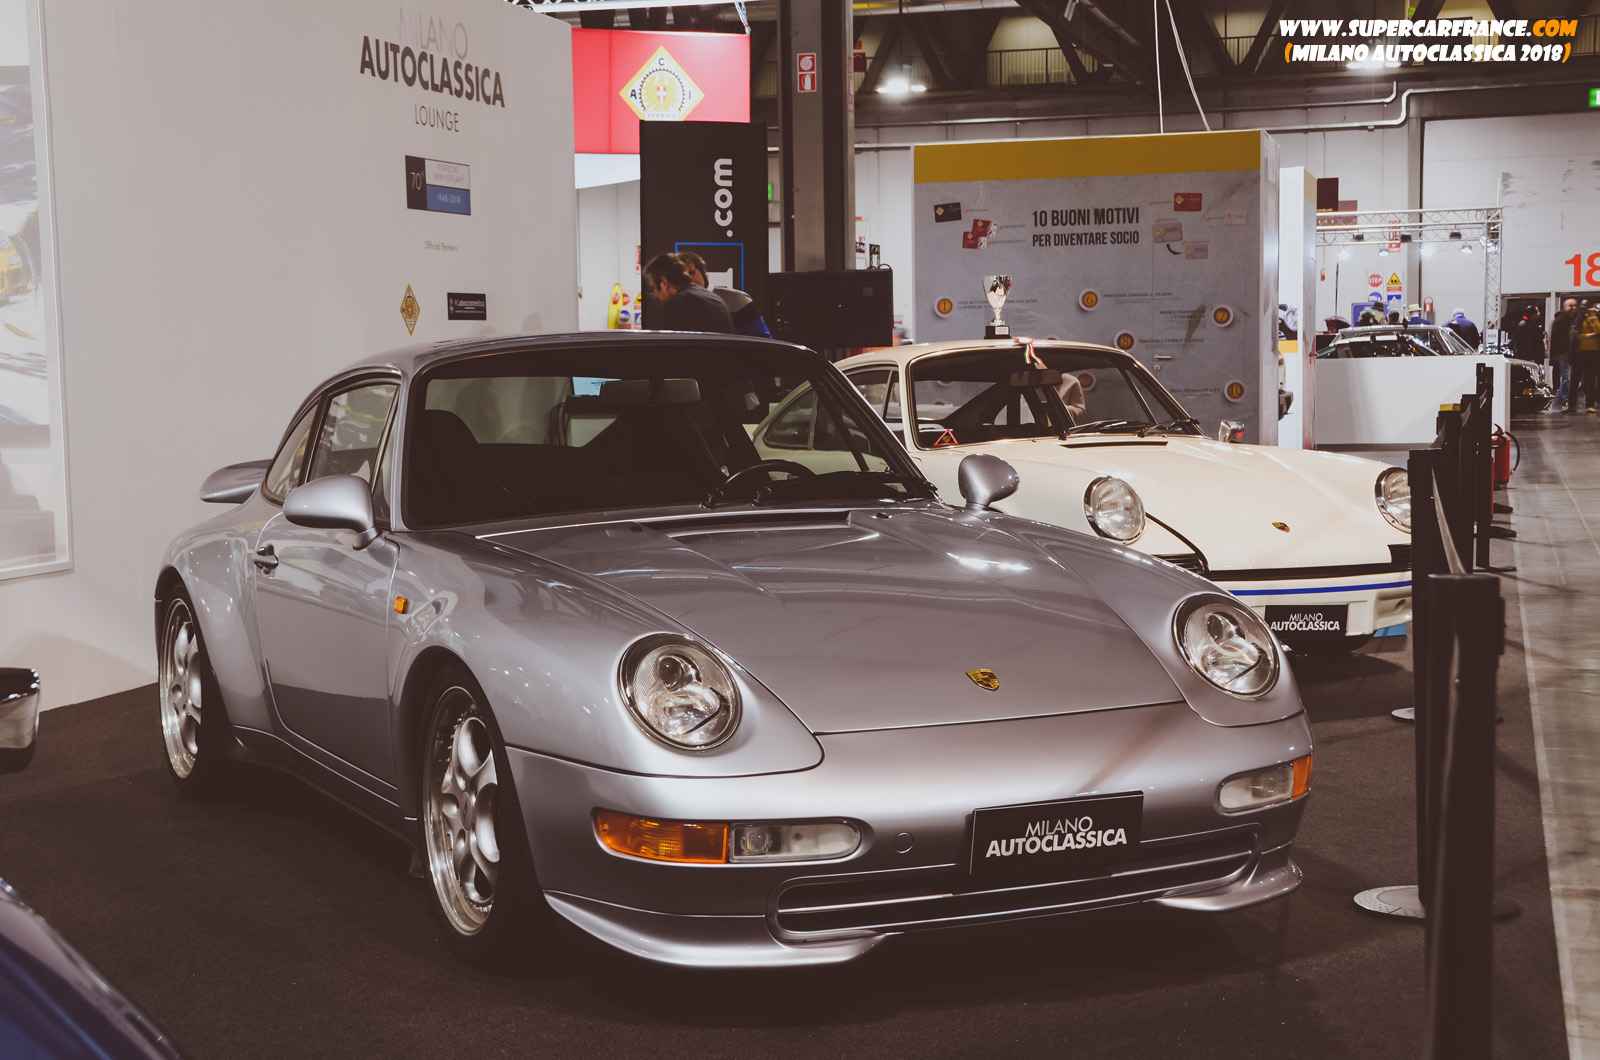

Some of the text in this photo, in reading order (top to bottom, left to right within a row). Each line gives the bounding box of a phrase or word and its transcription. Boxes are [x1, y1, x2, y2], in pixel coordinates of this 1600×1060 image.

[400, 7, 468, 60] MILANO
[360, 35, 505, 108] AUTOCLASSICA
[415, 104, 459, 132] LOUNGE
[714, 158, 733, 237] .com
[1033, 207, 1139, 227] 10 BUONI MOTIVI
[1033, 231, 1139, 247] PER DIVENTARE SOCIO
[1230, 384, 1242, 396] 10
[1270, 621, 1340, 631] AUTOCLASSICA
[1289, 612, 1323, 622] MILANO
[1025, 816, 1093, 838] MILANO
[985, 828, 1127, 858] AUTOCLASSICA
